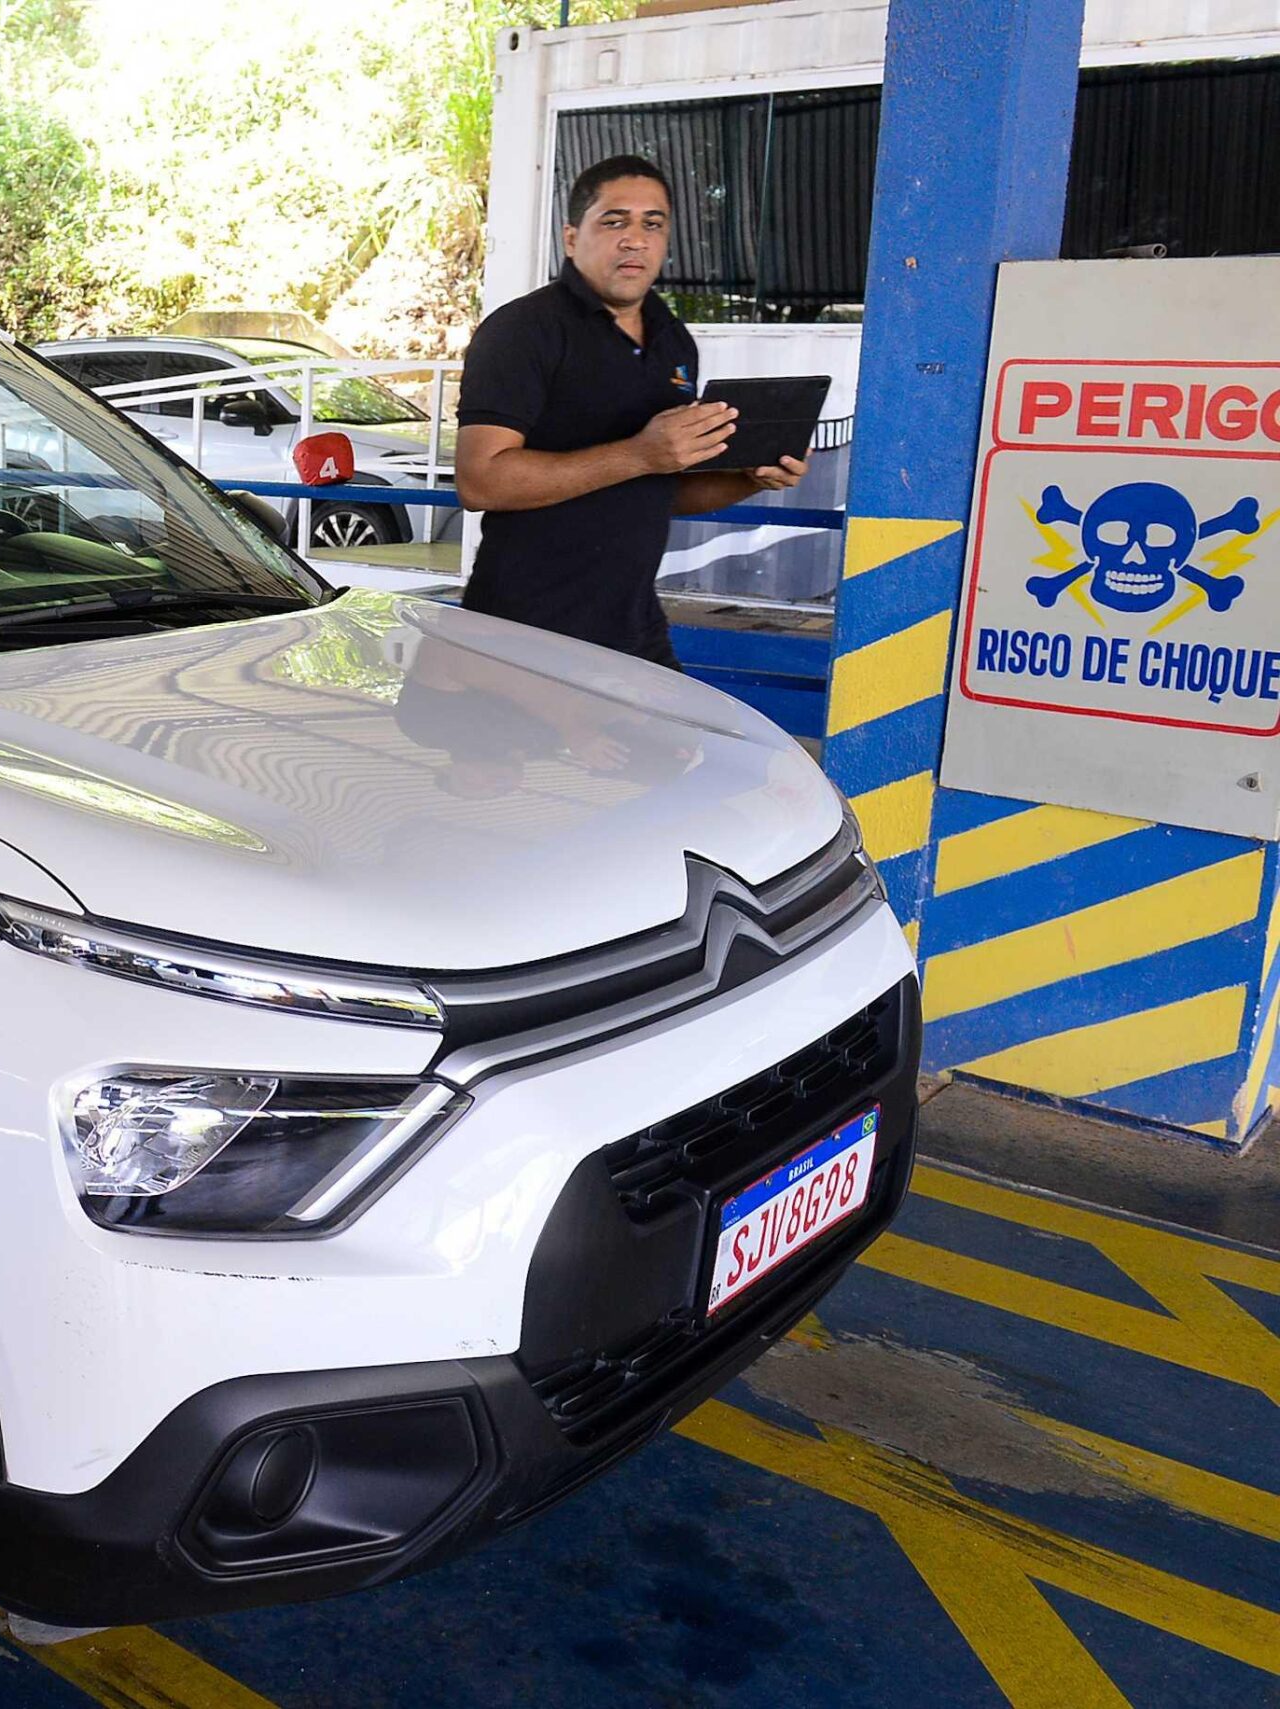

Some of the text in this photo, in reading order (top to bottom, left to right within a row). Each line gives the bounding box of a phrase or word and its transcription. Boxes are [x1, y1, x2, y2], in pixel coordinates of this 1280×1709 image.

[319, 456, 340, 480] 4
[976, 628, 1280, 704] RISCO DE CHOQUE
[788, 1156, 814, 1182] BRASIL
[727, 1152, 859, 1287] SJV8G98
